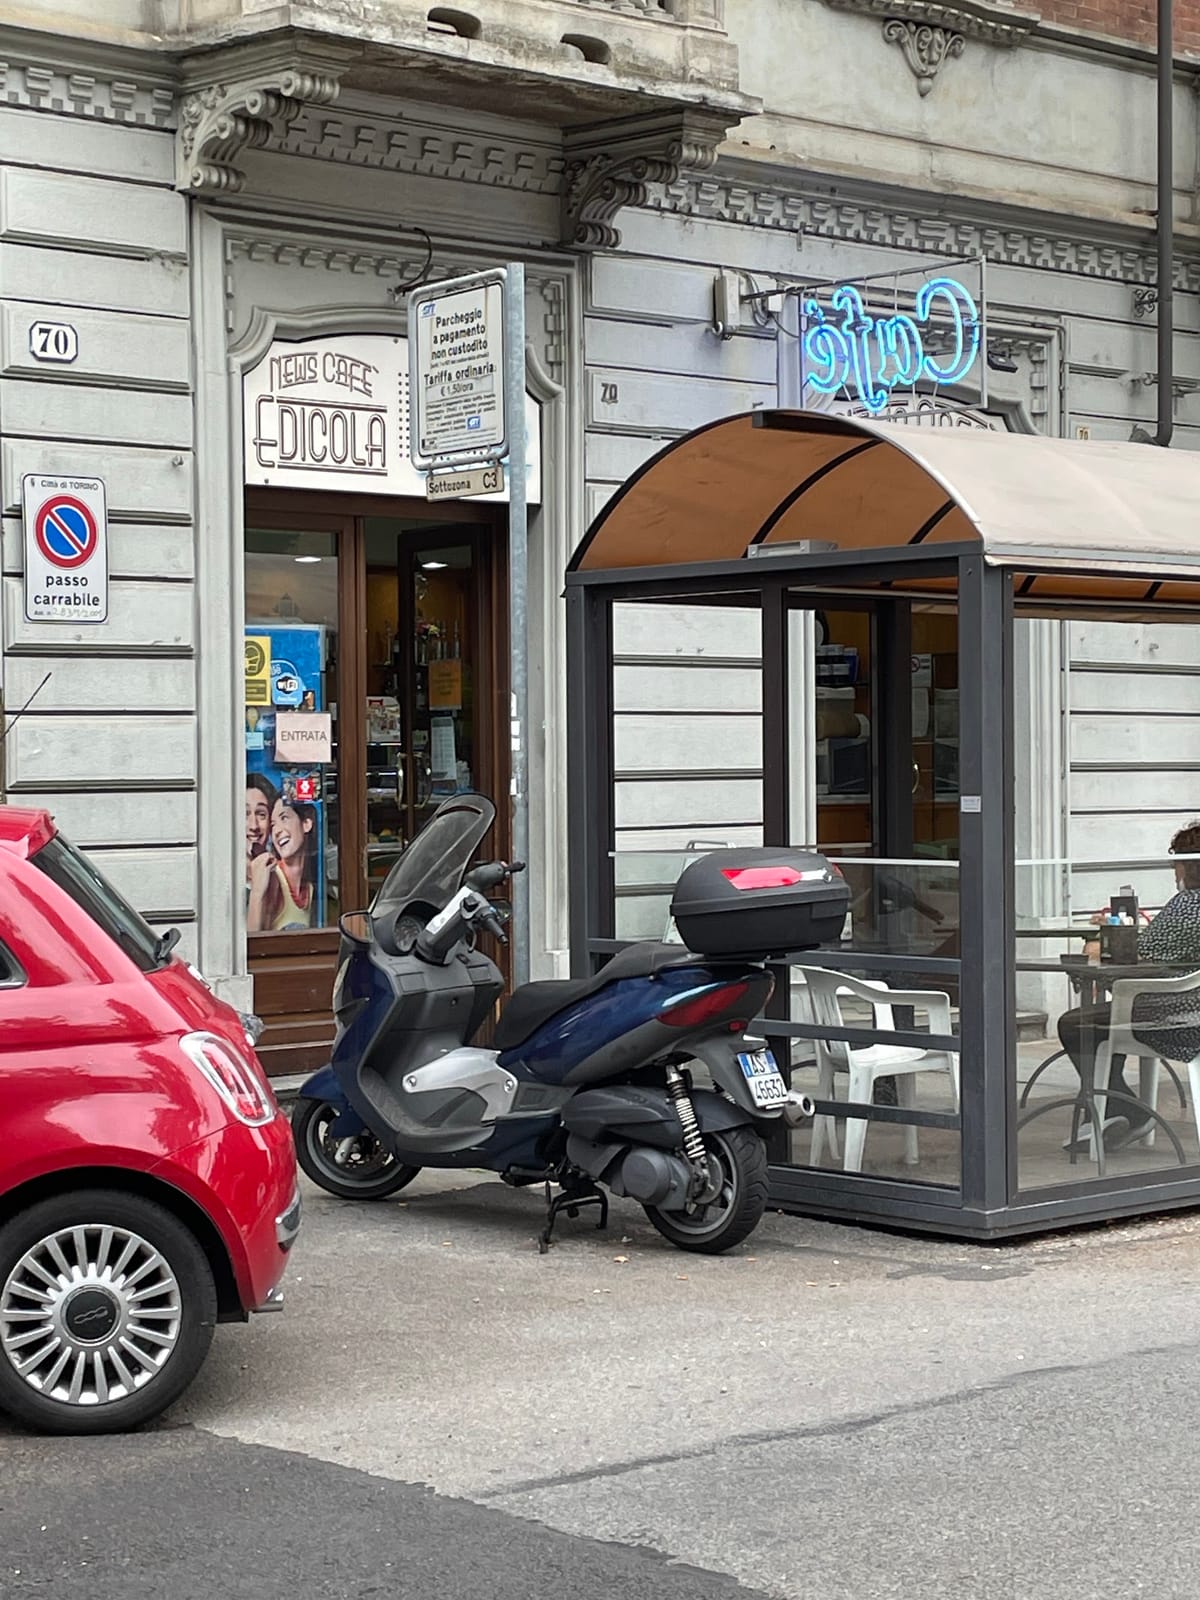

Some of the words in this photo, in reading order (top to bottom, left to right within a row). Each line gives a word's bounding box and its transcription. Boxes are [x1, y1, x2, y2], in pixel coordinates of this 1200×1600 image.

[436, 307, 482, 328] Parcheggio
[38, 327, 69, 356] 70
[433, 335, 438, 344] a
[440, 323, 486, 345] pagamento
[431, 349, 446, 360] non
[448, 339, 488, 356] custodito
[424, 369, 452, 385] Tariffa
[601, 382, 618, 401] 70
[252, 394, 387, 472] EDICOLA
[69, 481, 99, 491] TORINO
[429, 480, 471, 494] Sottozona
[483, 472, 497, 489] C3
[45, 574, 89, 589] passo
[34, 592, 100, 607] carrabile
[280, 730, 327, 742] ENTRATA
[750, 1054, 766, 1074] AS
[755, 1078, 787, 1100] 46632
